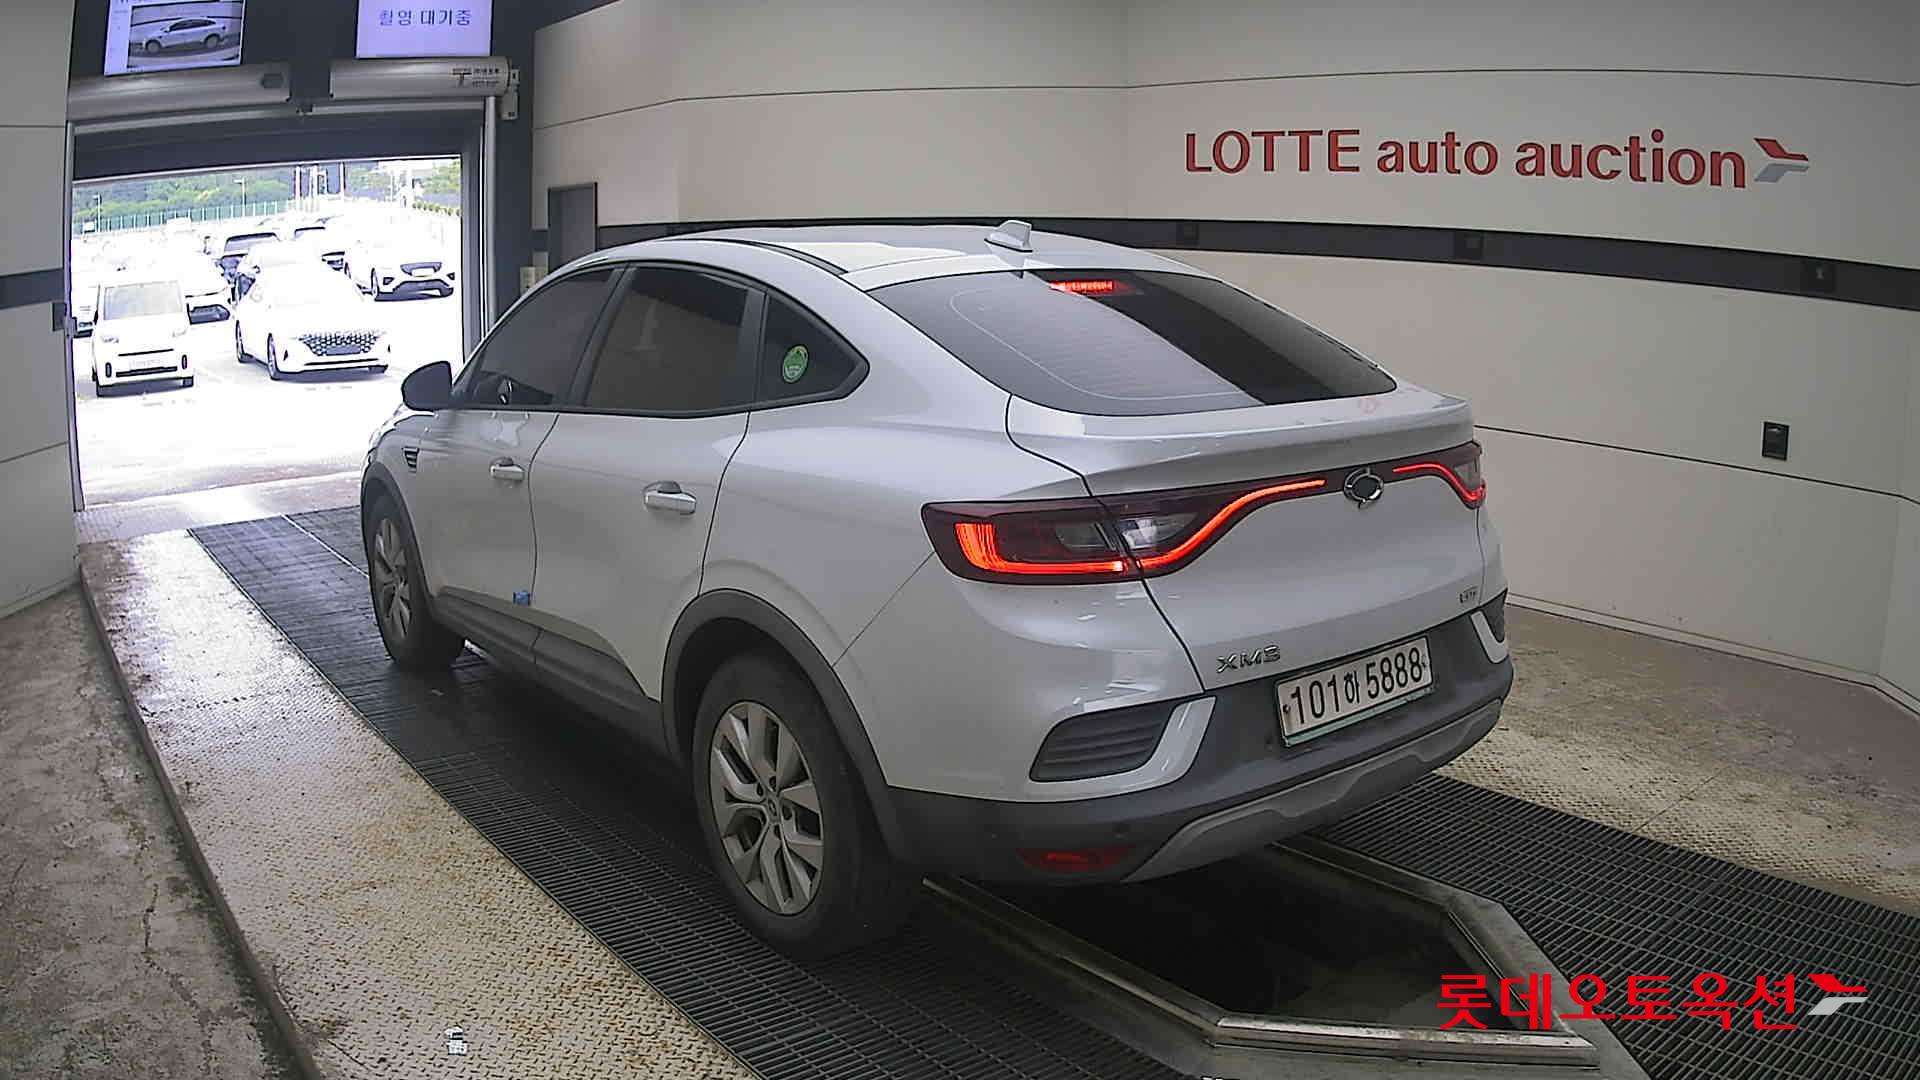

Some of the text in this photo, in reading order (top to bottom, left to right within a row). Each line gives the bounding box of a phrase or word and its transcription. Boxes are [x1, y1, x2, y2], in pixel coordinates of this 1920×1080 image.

[420, 9, 471, 26] 대기중
[1185, 129, 1746, 189] LOTTE auto auction
[1216, 645, 1281, 673] XM3
[1290, 646, 1423, 725] 101하 5888
